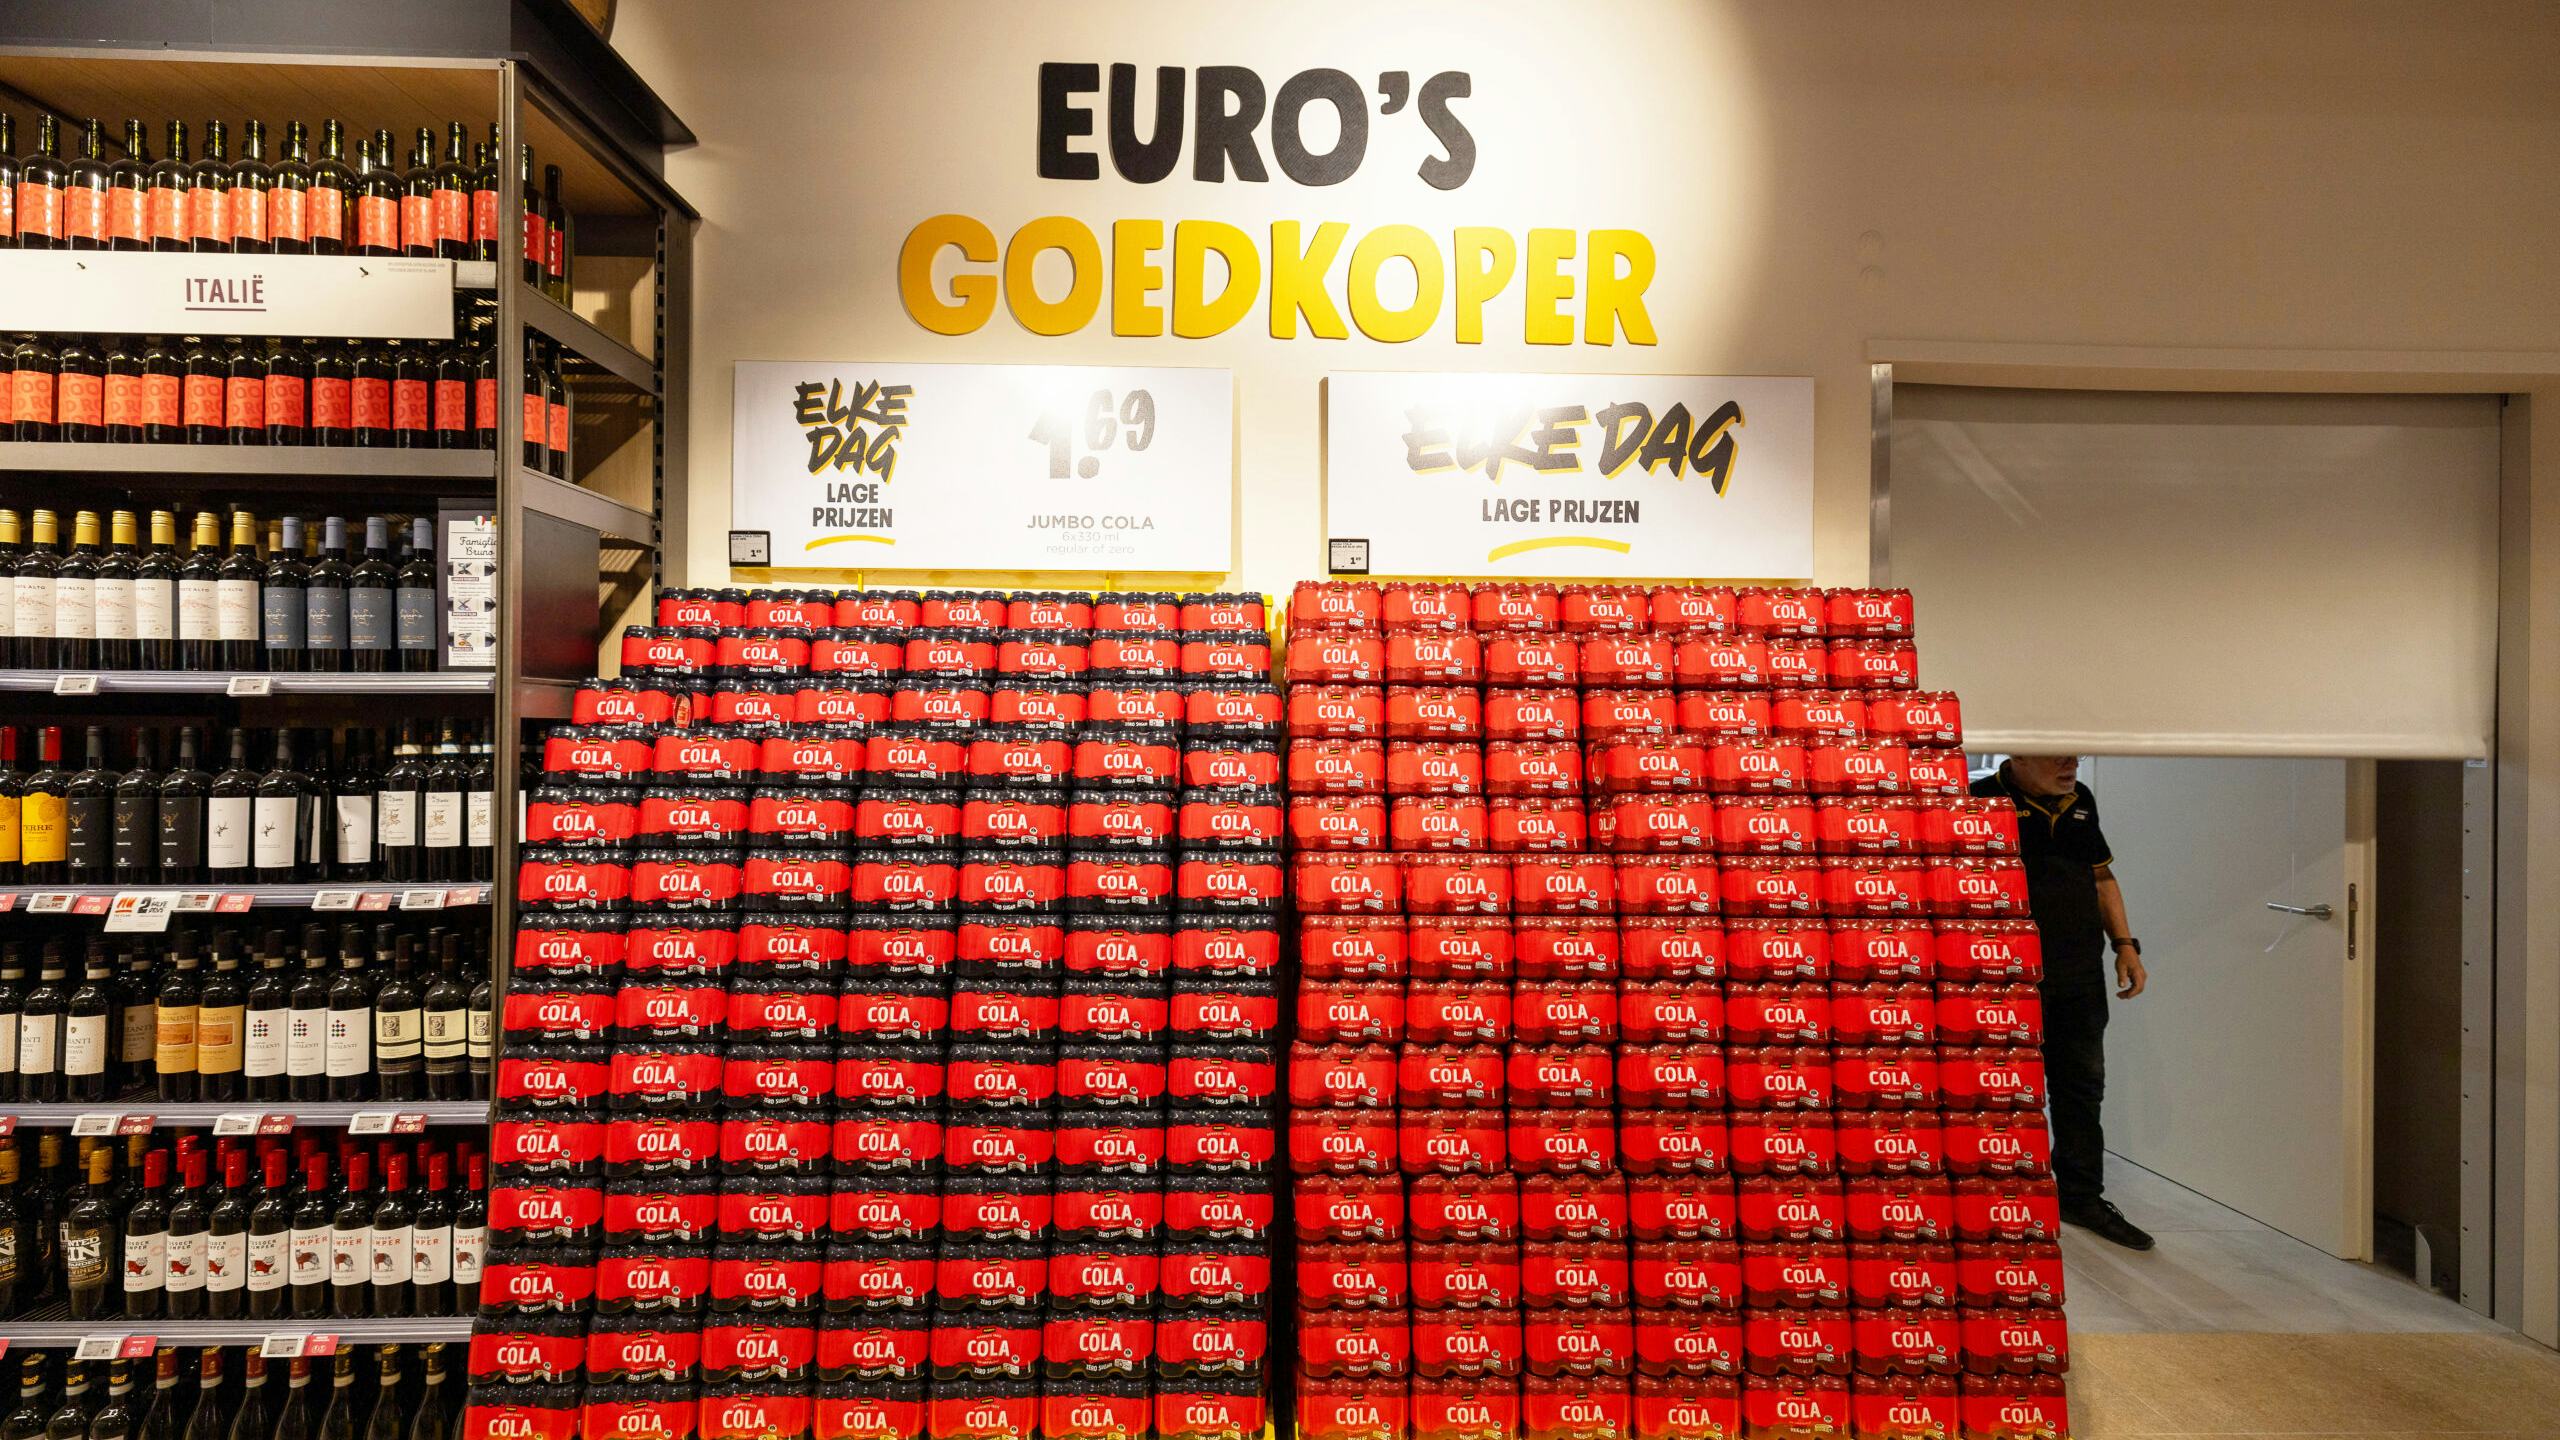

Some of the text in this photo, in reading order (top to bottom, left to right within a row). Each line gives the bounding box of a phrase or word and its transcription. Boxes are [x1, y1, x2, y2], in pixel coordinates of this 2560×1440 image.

[1037, 62, 1476, 190] EURO'S
[185, 274, 265, 304] ITALIË
[898, 213, 1658, 347] GOEDKOPER
[792, 378, 914, 433] ELKE
[805, 424, 902, 484] DAG
[1596, 400, 1746, 498] DAG
[826, 483, 879, 505] LAGE
[812, 506, 893, 529] PRIJZEN
[1482, 498, 1640, 525] LAGE PRIJZEN
[1027, 515, 1154, 530] JUMBO COLA
[677, 608, 712, 622] COLA
[1498, 602, 1534, 616] COLA
[1123, 612, 1157, 626] COLA
[833, 650, 870, 665] COLA
[1020, 651, 1057, 666] COLA
[1710, 651, 1747, 668] COLA
[1864, 658, 1899, 672] COLA
[596, 699, 636, 716] COLA
[735, 701, 772, 716] COLA
[924, 699, 962, 714] COLA
[1117, 700, 1156, 715] COLA
[1317, 704, 1356, 719] COLA
[1614, 707, 1653, 721] COLA
[1003, 751, 1043, 768] COLA
[1519, 761, 1559, 776] COLA
[1739, 755, 1780, 772] COLA
[1209, 761, 1247, 778] COLA
[552, 813, 596, 832] COLA
[668, 809, 711, 826] COLA
[776, 809, 817, 825] COLA
[1103, 813, 1143, 830] COLA
[1421, 816, 1460, 832] COLA
[1846, 817, 1889, 834] COLA
[771, 871, 814, 887] COLA
[883, 874, 925, 893] COLA
[1330, 875, 1372, 893] COLA
[1545, 875, 1587, 893] COLA
[1656, 877, 1697, 895] COLA
[539, 942, 582, 959] COLA
[767, 937, 810, 954] COLA
[989, 936, 1032, 953] COLA
[1204, 941, 1246, 960] COLA
[1332, 940, 1375, 957] COLA
[1970, 944, 2012, 960] COLA
[646, 999, 689, 1018] COLA
[867, 1006, 910, 1023] COLA
[1087, 1006, 1130, 1024] COLA
[1328, 1004, 1370, 1021] COLA
[1546, 1003, 1589, 1020] COLA
[1764, 1007, 1807, 1024] COLA
[756, 1071, 799, 1089] COLA
[1429, 1067, 1473, 1084] COLA
[1654, 1066, 1697, 1083] COLA
[1979, 1071, 2022, 1088] COLA
[516, 1134, 560, 1154] COLA
[636, 1133, 681, 1152] COLA
[858, 1132, 901, 1152] COLA
[972, 1139, 1016, 1157] COLA
[1197, 1137, 1240, 1155] COLA
[1544, 1137, 1589, 1154] COLA
[1659, 1136, 1702, 1153] COLA
[1874, 1138, 1918, 1154] COLA
[635, 1206, 681, 1224] COLA
[858, 1204, 902, 1223] COLA
[1090, 1203, 1133, 1221] COLA
[1329, 1204, 1373, 1220] COLA
[1444, 1204, 1488, 1221] COLA
[1665, 1203, 1709, 1220] COLA
[1777, 1204, 1821, 1222] COLA
[1989, 1205, 2032, 1223] COLA
[509, 1276, 554, 1295] COLA
[744, 1272, 787, 1291] COLA
[972, 1271, 1016, 1289] COLA
[1555, 1269, 1599, 1287] COLA
[1889, 1271, 1932, 1289] COLA
[1079, 1332, 1122, 1352] COLA
[1192, 1332, 1234, 1352] COLA
[1335, 1338, 1380, 1355] COLA
[1446, 1335, 1490, 1354] COLA
[1780, 1330, 1823, 1349] COLA
[2000, 1329, 2044, 1347] COLA
[496, 1346, 542, 1366] COLA
[622, 1344, 666, 1364] COLA
[853, 1340, 896, 1359] COLA
[722, 1408, 766, 1429] COLA
[1070, 1408, 1115, 1428] COLA
[1185, 1406, 1230, 1425] COLA
[1335, 1407, 1380, 1425] COLA
[1446, 1406, 1491, 1424] COLA
[1668, 1408, 1711, 1427] COLA
[1777, 1401, 1822, 1419] COLA
[1888, 1407, 1932, 1425] COLA
[2000, 1406, 2044, 1425] COLA
[488, 1418, 532, 1438] COLA
[843, 1411, 887, 1430] COLA
